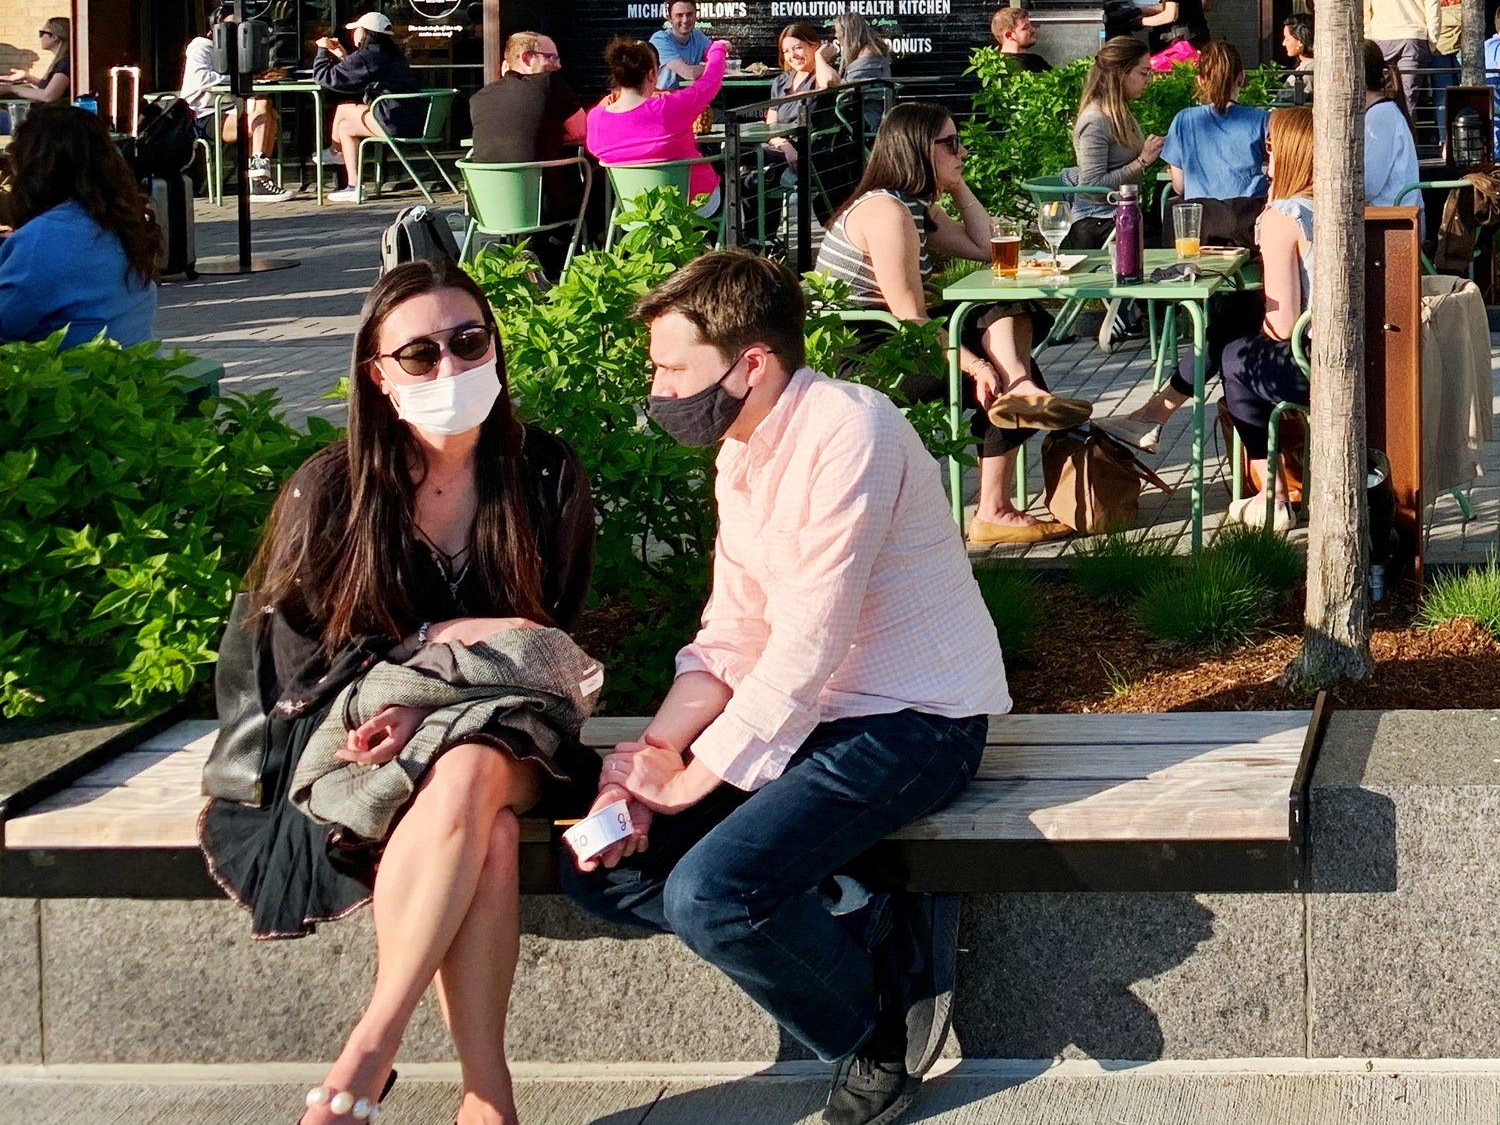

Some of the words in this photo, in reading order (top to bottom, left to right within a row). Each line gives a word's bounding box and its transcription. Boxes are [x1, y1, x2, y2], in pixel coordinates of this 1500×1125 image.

[771, 1, 846, 17] REVOLUTION
[850, 0, 894, 15] HEALTH
[899, 0, 951, 15] KITCHEN
